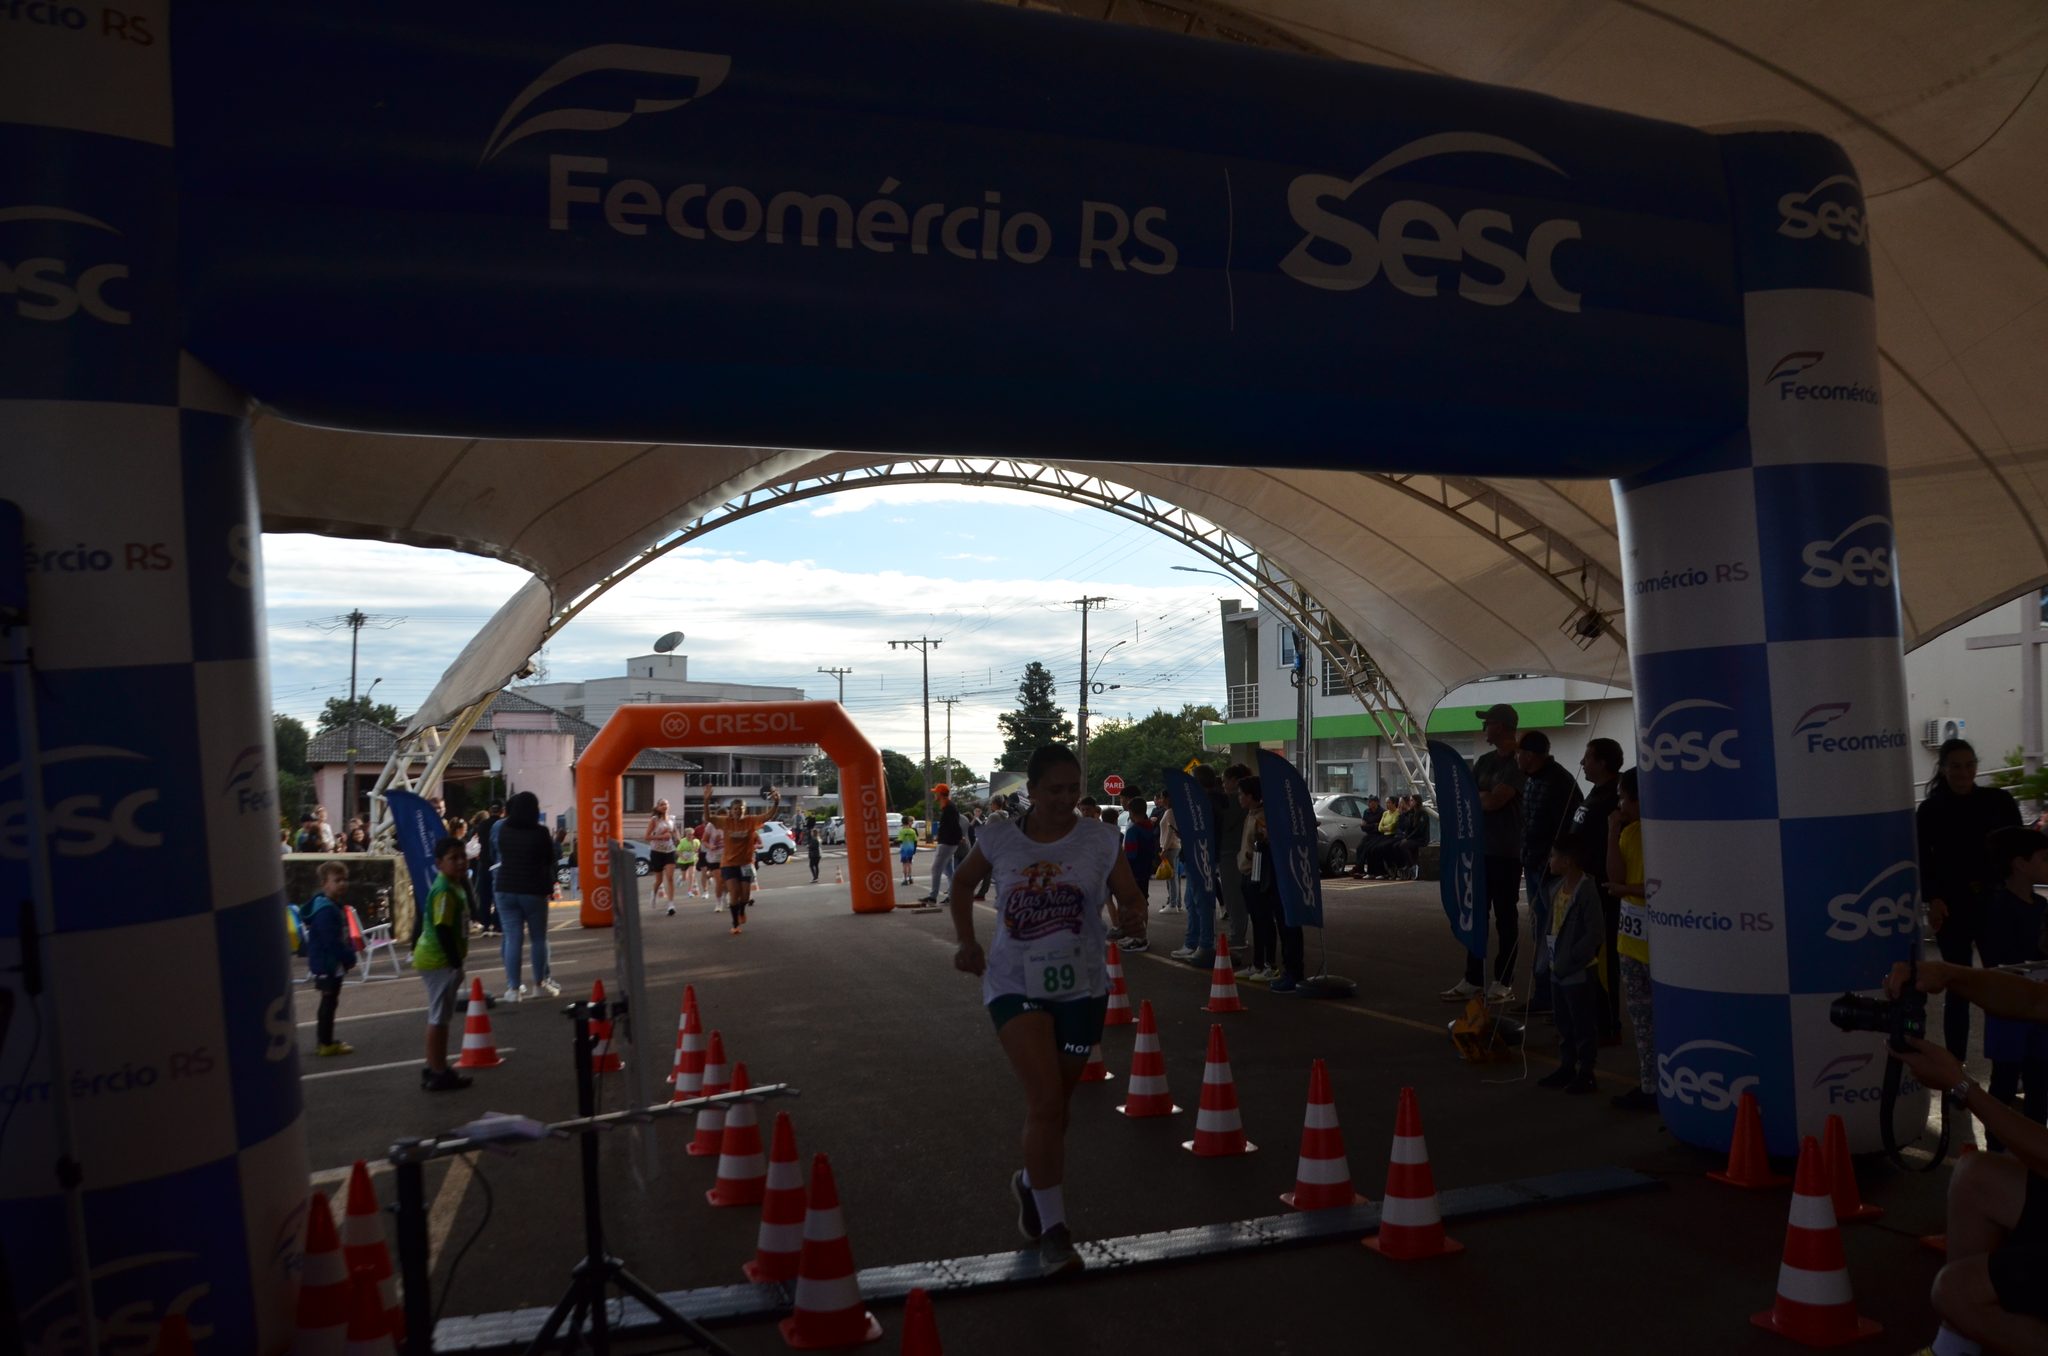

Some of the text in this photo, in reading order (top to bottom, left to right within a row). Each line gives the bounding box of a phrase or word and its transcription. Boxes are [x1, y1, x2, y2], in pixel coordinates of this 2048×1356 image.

[102, 8, 154, 46] RS
[548, 153, 1180, 276] Fecomércio RS
[1776, 191, 1869, 247] Ses
[1278, 172, 1582, 313] Sesc
[125, 542, 174, 572] RS
[1714, 561, 1750, 584] RS
[700, 711, 804, 735] CRESOL
[860, 777, 883, 863] CRESOL
[1015, 904, 1079, 930] Param
[1739, 912, 1775, 933] RS
[1044, 964, 1075, 992] 89
[169, 1046, 215, 1080] RS
